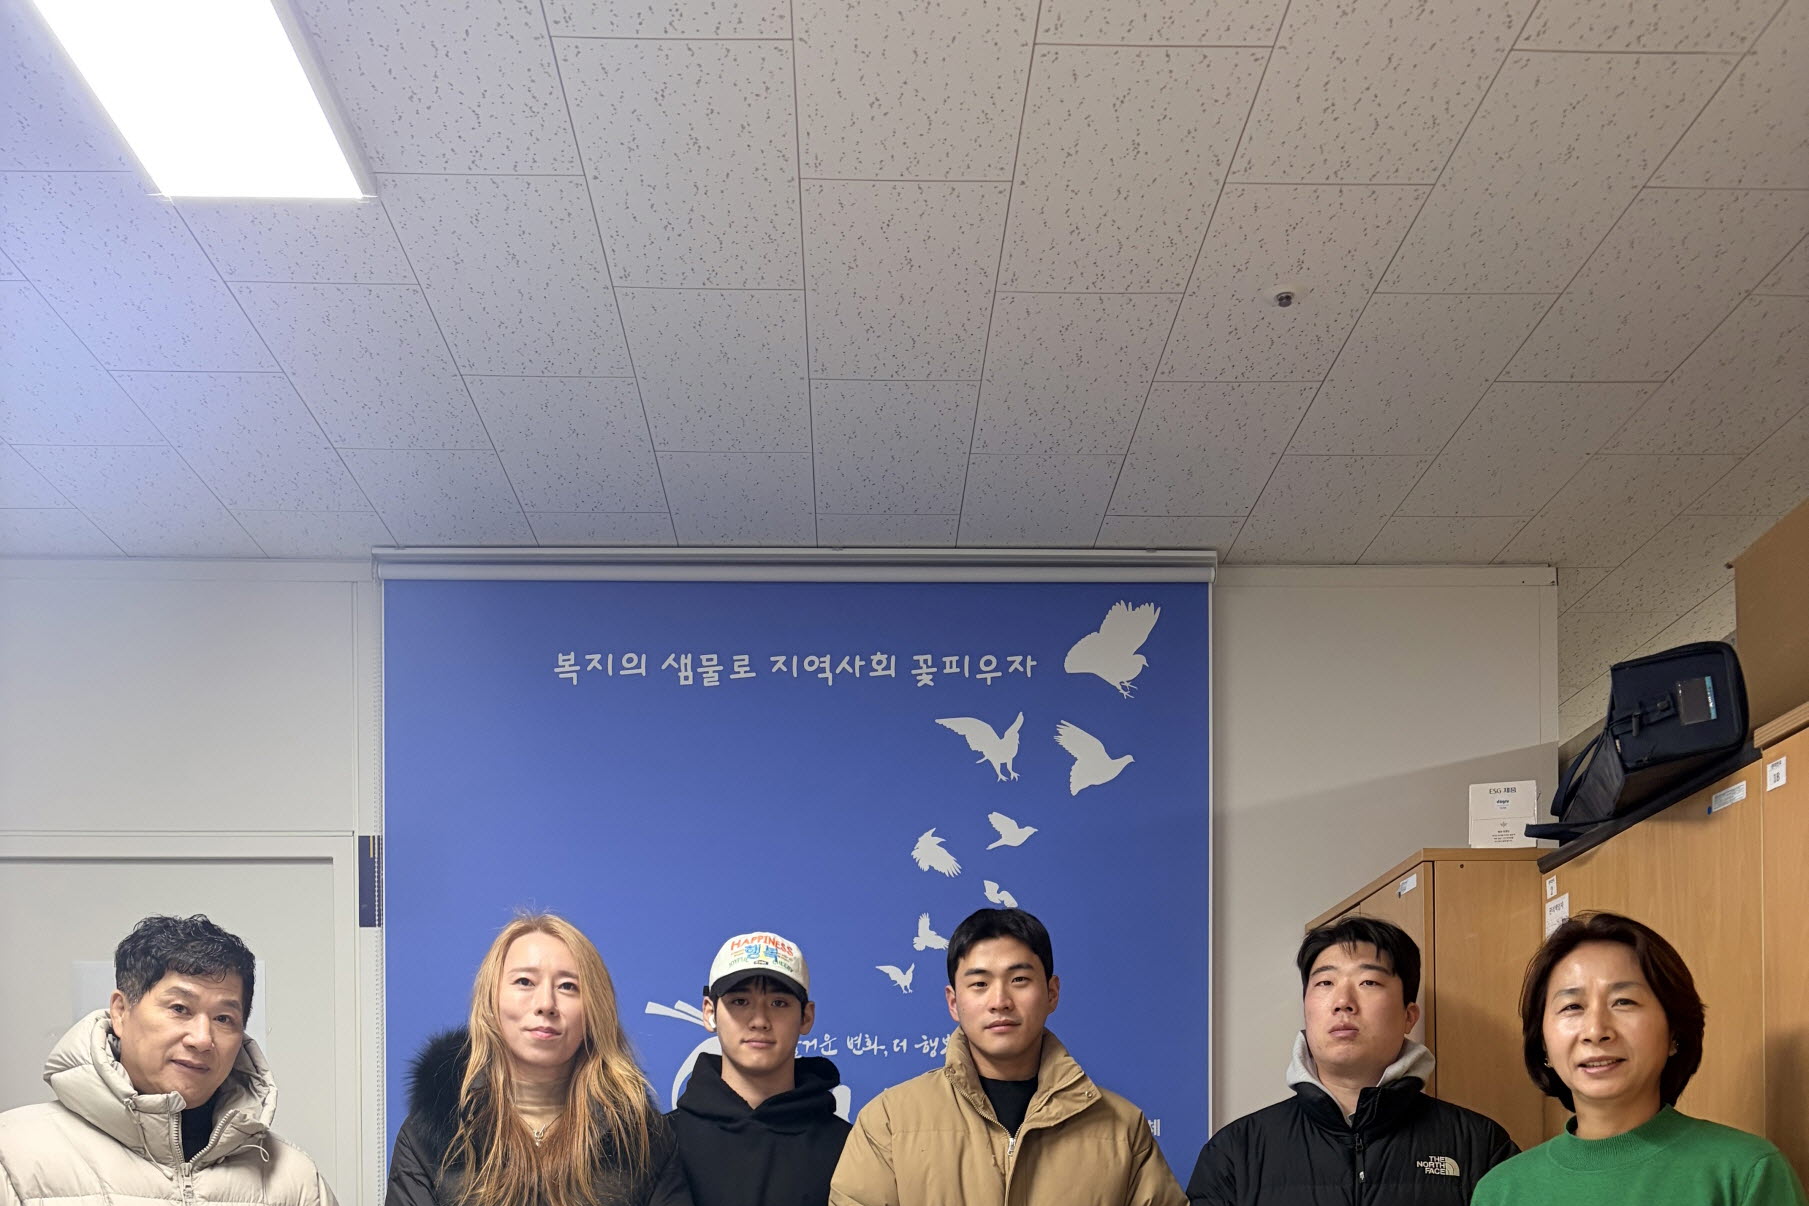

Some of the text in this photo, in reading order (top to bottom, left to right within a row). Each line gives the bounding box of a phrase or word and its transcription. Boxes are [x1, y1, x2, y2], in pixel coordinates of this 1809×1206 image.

[553, 652, 1037, 687] 복지의 샘물로 지역사회 꽃피우자
[730, 935, 793, 957] HAPPINESS
[893, 1038, 907, 1053] 더
[1416, 1161, 1446, 1169] NORTH
